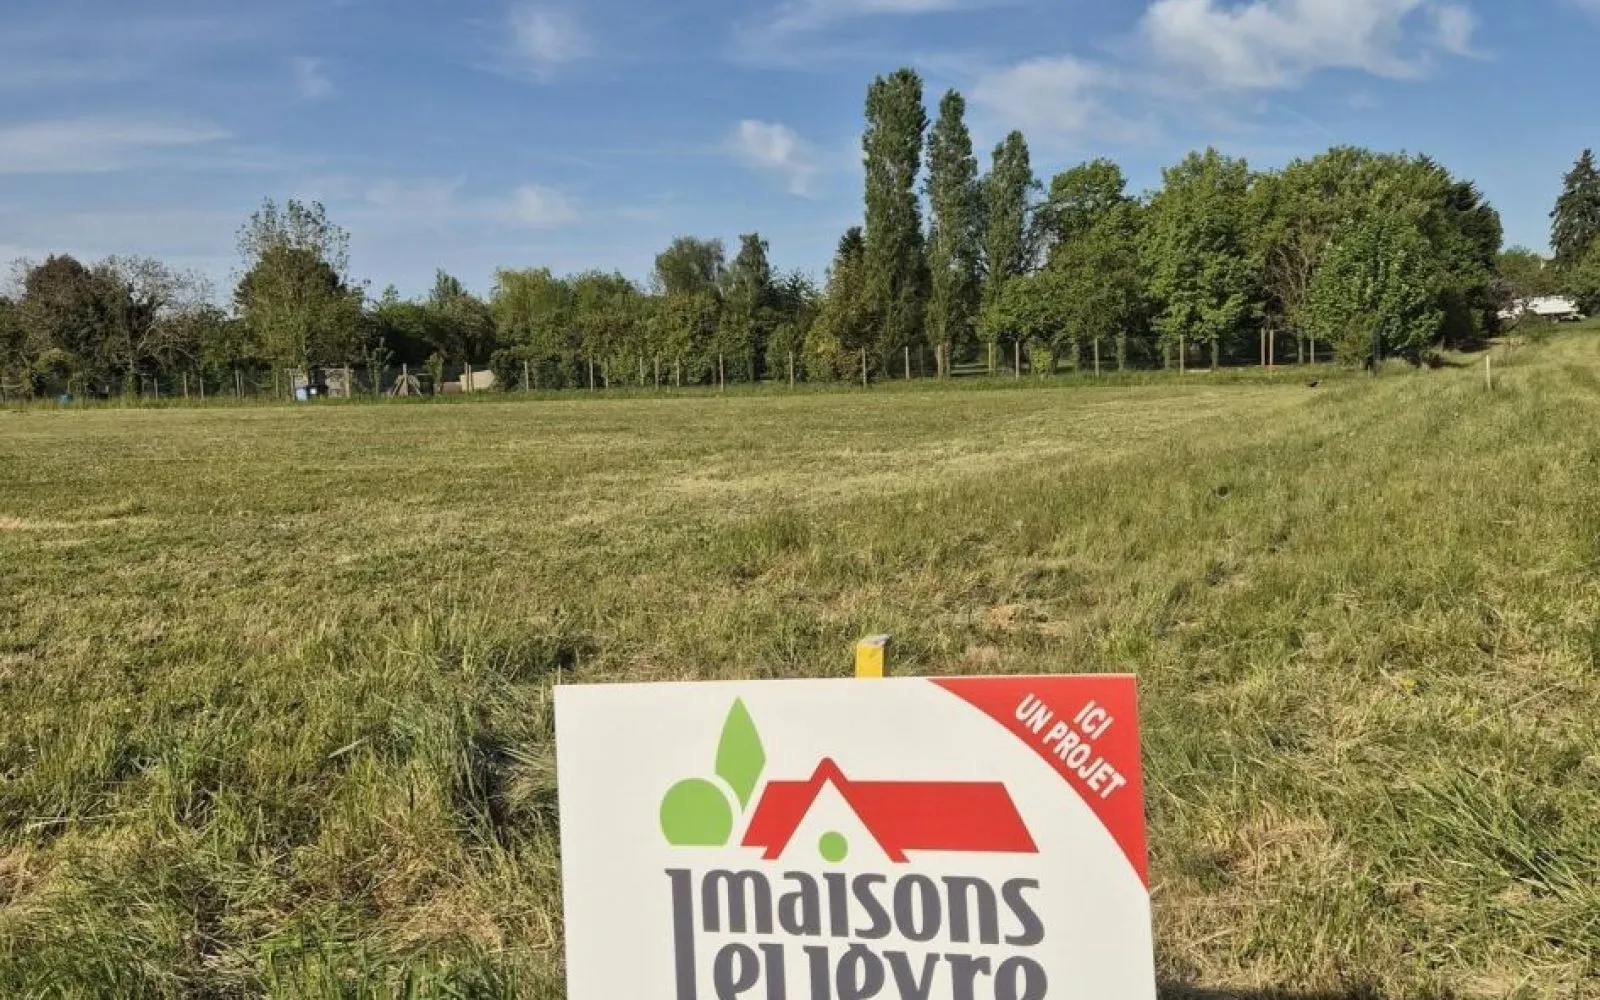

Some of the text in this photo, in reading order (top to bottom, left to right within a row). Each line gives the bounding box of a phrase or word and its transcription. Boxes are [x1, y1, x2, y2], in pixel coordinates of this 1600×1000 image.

[1015, 693, 1127, 799] UN PROJET
[1073, 699, 1114, 740] ICI
[702, 869, 1044, 946] maisons
